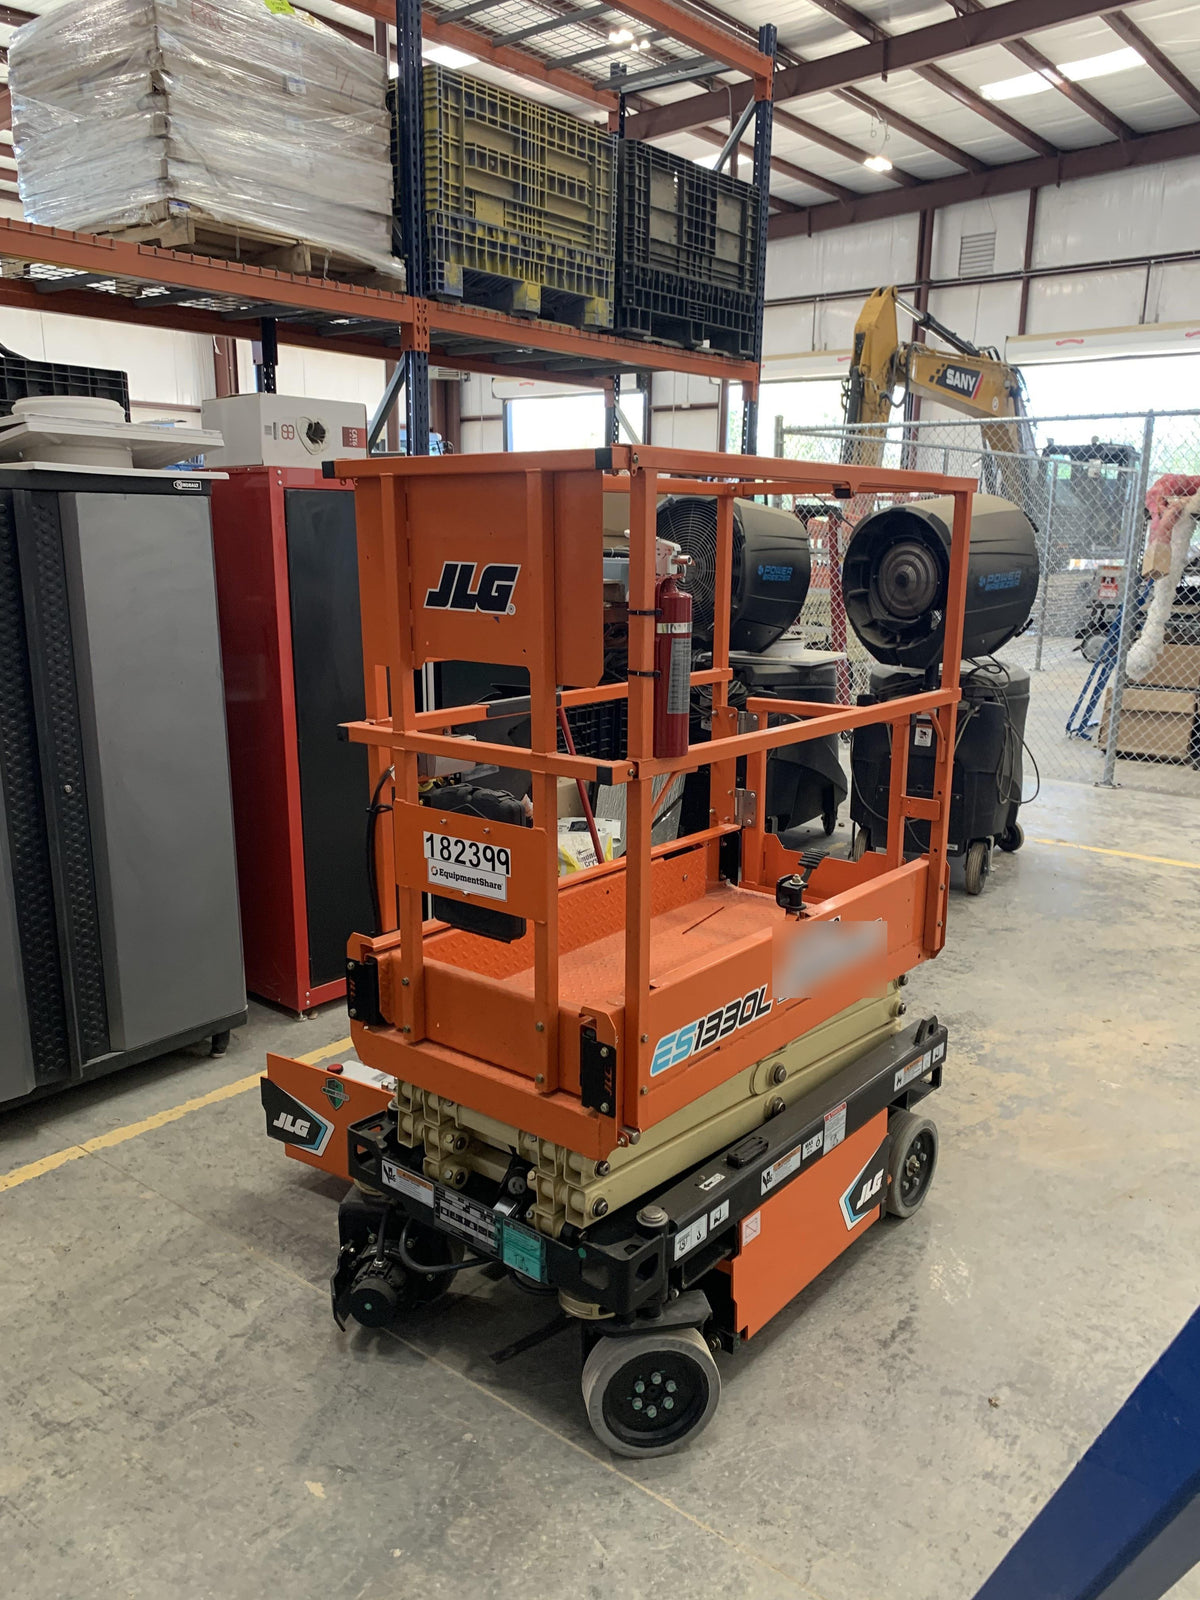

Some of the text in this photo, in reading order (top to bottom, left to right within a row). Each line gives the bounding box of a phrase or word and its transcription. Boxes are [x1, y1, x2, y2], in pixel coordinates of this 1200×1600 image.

[945, 368, 976, 392] SANY
[424, 561, 521, 615] JLG
[425, 833, 510, 876] 182399
[438, 868, 503, 891] EquipmentShare
[650, 985, 773, 1077] ES1330L
[273, 1112, 311, 1138] JLG
[856, 1168, 884, 1211] JLG
